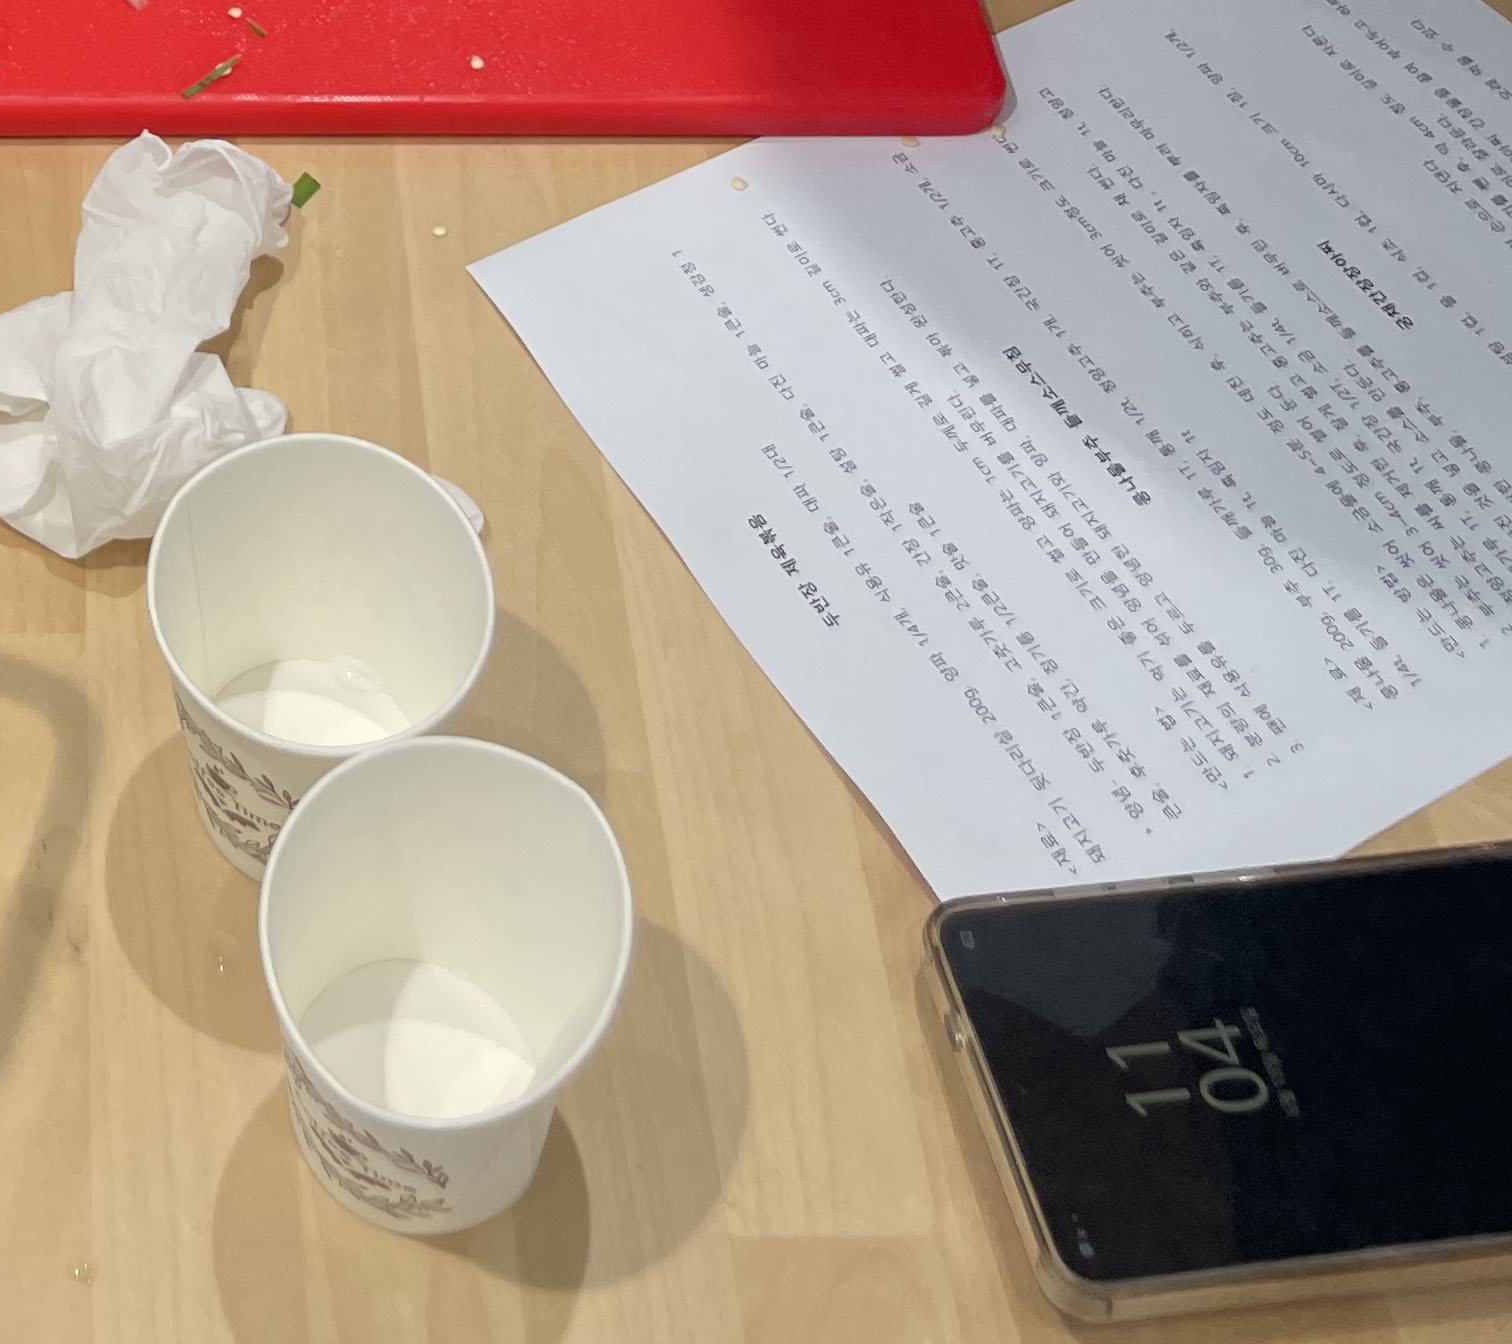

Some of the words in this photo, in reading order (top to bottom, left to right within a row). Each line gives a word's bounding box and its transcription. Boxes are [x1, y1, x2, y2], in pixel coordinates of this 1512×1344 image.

[889, 150, 921, 177] 소금
[670, 248, 684, 258] 1
[783, 238, 824, 277] 길이로
[678, 260, 717, 299] 생강청
[817, 279, 847, 306] 3cm
[1001, 272, 1045, 313] 국간장
[1314, 239, 1417, 331] 궁채간장장아찌
[840, 307, 883, 348] 대파는
[767, 372, 799, 402] 다진
[1000, 344, 1086, 431] 들깨소스무침
[1063, 340, 1120, 394] 청양고추
[902, 379, 935, 409] 길게
[928, 410, 973, 454] 두께로
[1177, 428, 1198, 444] 1t
[760, 442, 798, 480] 1/2대
[826, 444, 860, 476] 설탕
[967, 455, 999, 484] 1cm
[1077, 431, 1154, 508] 콩나물부추
[789, 481, 824, 514] 대파
[903, 499, 944, 538] 1큰술
[992, 485, 1041, 534] 양파는
[1044, 468, 1115, 541] 돼지고기와
[744, 511, 804, 577] 제육볶음
[898, 534, 935, 568] 간장
[936, 539, 971, 571] 맛술
[1108, 541, 1157, 588] 양념한
[1285, 545, 1323, 578] 다진
[851, 559, 896, 605] 식용유
[1062, 565, 1110, 613] 크기로
[1096, 567, 1145, 614] 양념을
[1280, 576, 1318, 611] 부추
[1369, 562, 1415, 604] 방법>
[795, 578, 845, 630] 두반장
[1150, 590, 1198, 636] 두르고
[966, 613, 1025, 674] 고춧가루
[1013, 628, 1061, 676] 참기름
[1103, 613, 1141, 648] 좋은
[1409, 604, 1470, 661] <만드는
[926, 648, 962, 683] 양파
[1134, 649, 1170, 682] 먹기
[1317, 654, 1349, 683] 료>
[1147, 702, 1179, 732] 법>
[1251, 701, 1289, 736] 팬에
[1344, 684, 1377, 713] <재
[1165, 684, 1242, 763] 돼지고기는
[1214, 699, 1266, 750] 분량의
[990, 725, 1053, 793] 뒷다리살
[1059, 723, 1110, 775] 두반장
[1087, 715, 1151, 781] 후춧가루
[1174, 733, 1233, 794] <만드는
[1028, 818, 1083, 878] <재료>
[1045, 795, 1111, 865] 돼지고기
[1104, 1041, 1191, 1117] 11
[1177, 1018, 1269, 1112] 04
